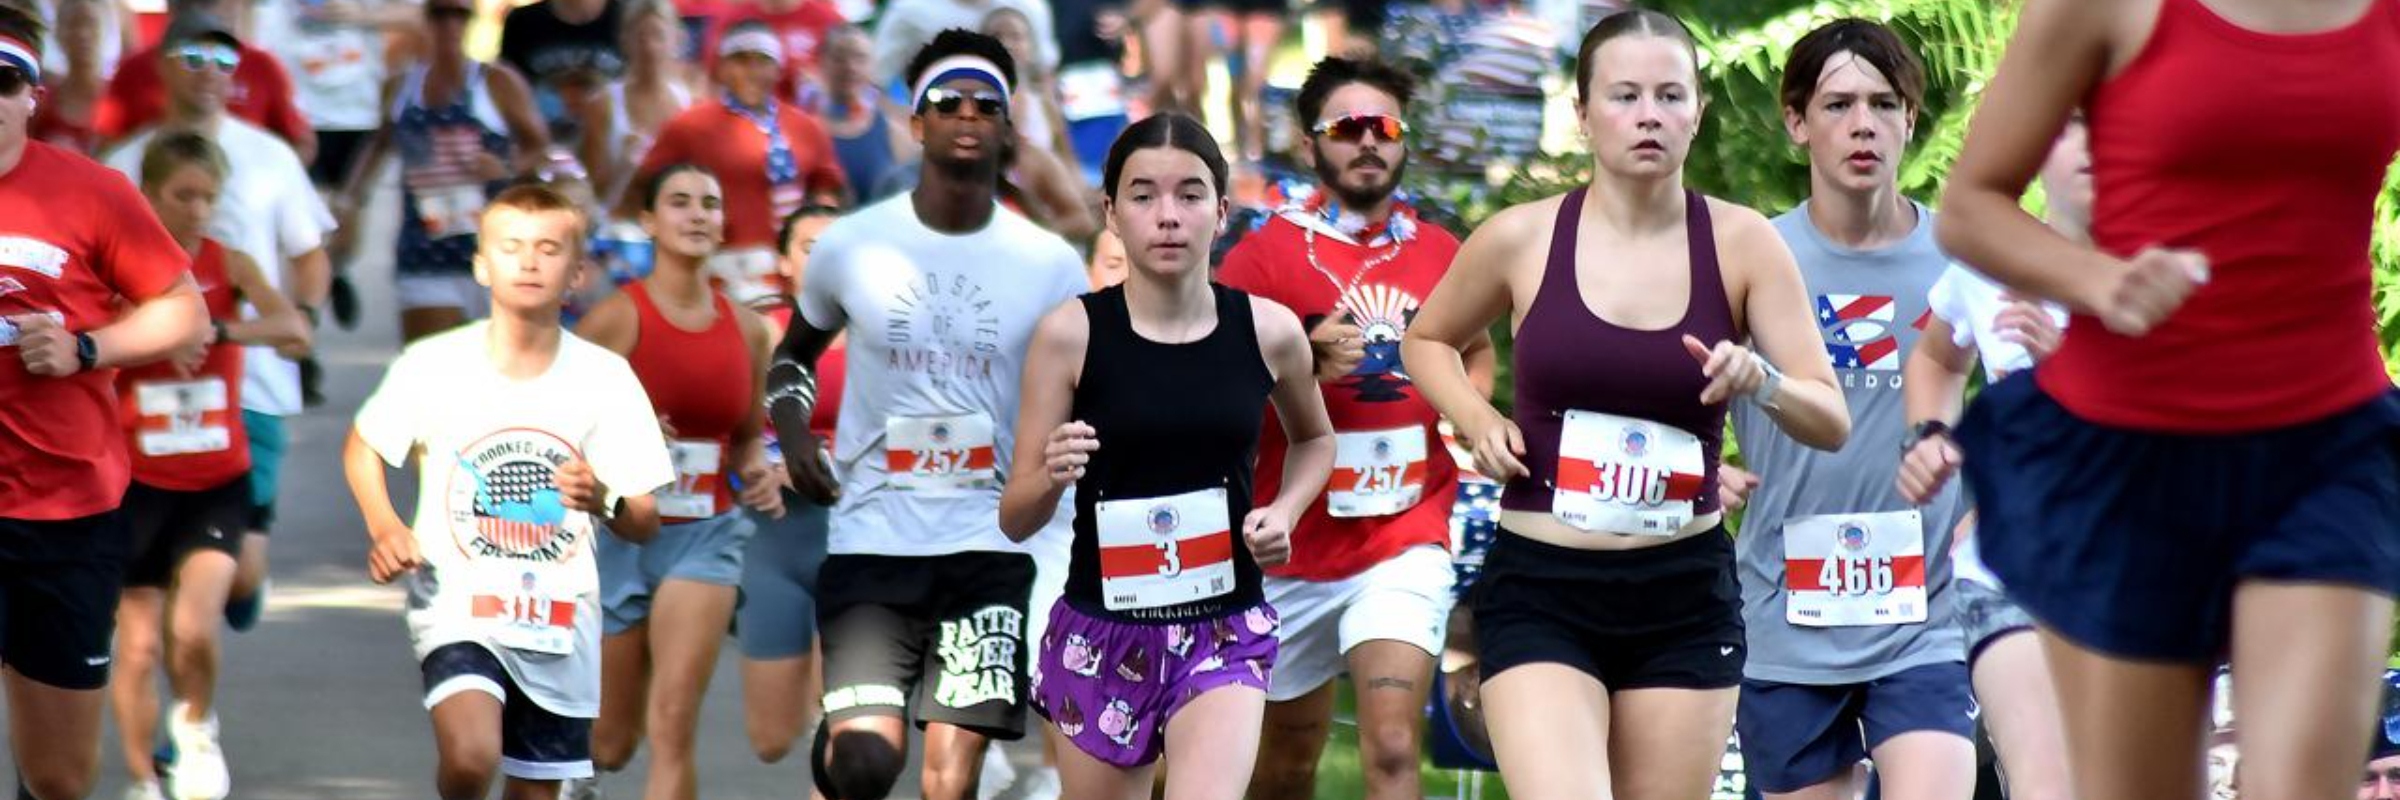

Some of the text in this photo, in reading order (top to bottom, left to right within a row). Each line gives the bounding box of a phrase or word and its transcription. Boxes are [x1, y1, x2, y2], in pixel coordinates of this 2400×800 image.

[887, 272, 999, 353] UNITED STATES
[932, 314, 954, 335] OF
[887, 348, 993, 380] AMERICA
[912, 446, 969, 476] 252
[1353, 463, 1407, 497] 257
[1589, 458, 1672, 508] 306
[1154, 539, 1182, 579] 3
[1817, 552, 1895, 597] 466
[496, 595, 551, 627] 319
[939, 605, 1023, 649] FAITH
[937, 637, 1017, 676] OVER
[933, 668, 1017, 709] FEAR
